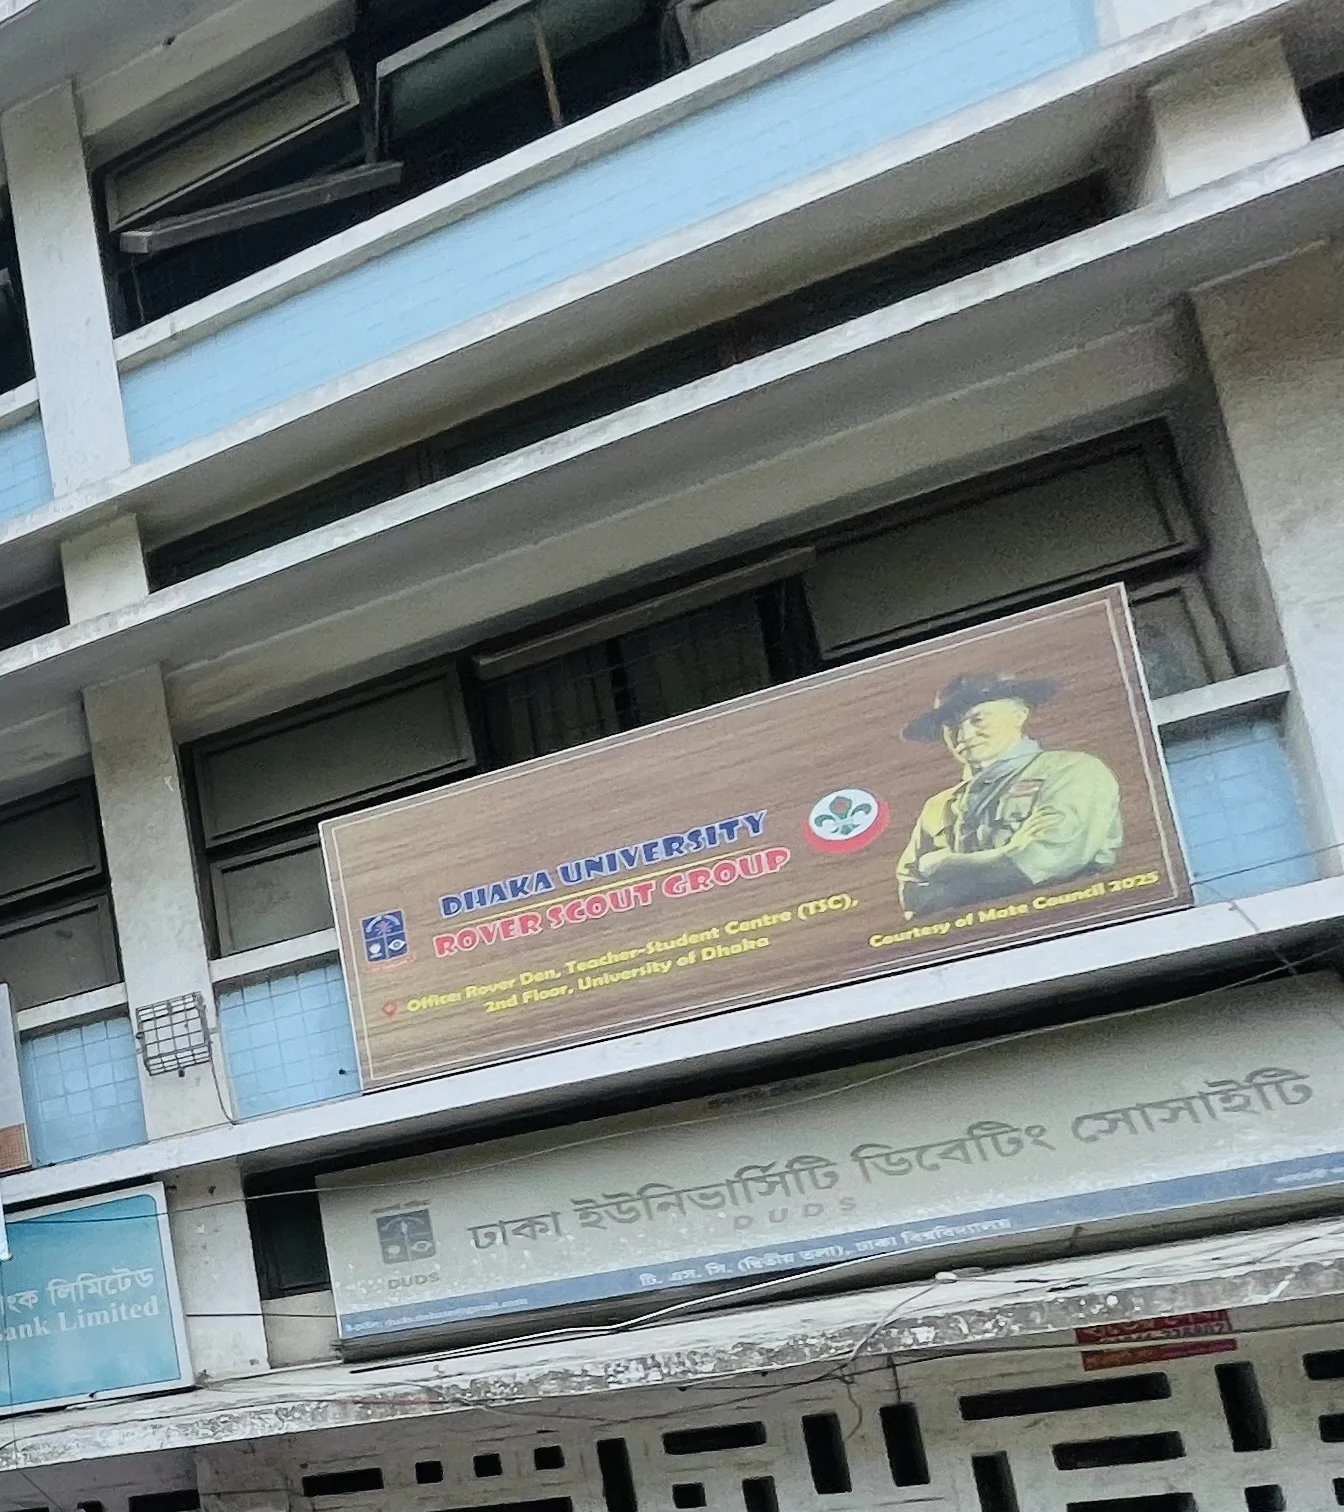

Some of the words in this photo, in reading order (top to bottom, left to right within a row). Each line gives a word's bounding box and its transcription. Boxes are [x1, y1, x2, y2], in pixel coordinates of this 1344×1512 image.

[432, 910, 543, 959] ROVER
[547, 880, 658, 931] SCOUT
[660, 845, 792, 900] GROUP
[438, 869, 557, 920] DHAKA
[556, 808, 769, 886] UNIVERSITY
[868, 918, 952, 950] Courtesy
[955, 912, 975, 930] of
[976, 901, 1031, 924] Mate
[1032, 880, 1105, 911] Council
[1107, 870, 1161, 893] 2025
[464, 976, 517, 1001] Rover
[565, 927, 720, 977] Teacher-Student
[723, 908, 794, 936] Centre
[483, 994, 519, 1015] 2nd
[520, 984, 574, 1007] Floor,
[577, 957, 675, 992] University
[675, 951, 698, 970] of
[700, 934, 772, 963] Dhaka
[466, 1210, 564, 1252] ঢাকা
[570, 1152, 841, 1230] ইউনিভার্সিটি
[850, 1120, 1056, 1184] ডিবেটিং
[1071, 1066, 1314, 1144] সোসাইটি
[855, 1235, 898, 1255] ঢাকা
[901, 1218, 1013, 1247] বিশ্ববিদ্যালয়
[44, 1266, 156, 1307] লিমিটেড
[58, 1294, 161, 1333] Limited
[388, 1271, 440, 1291] DUDS
